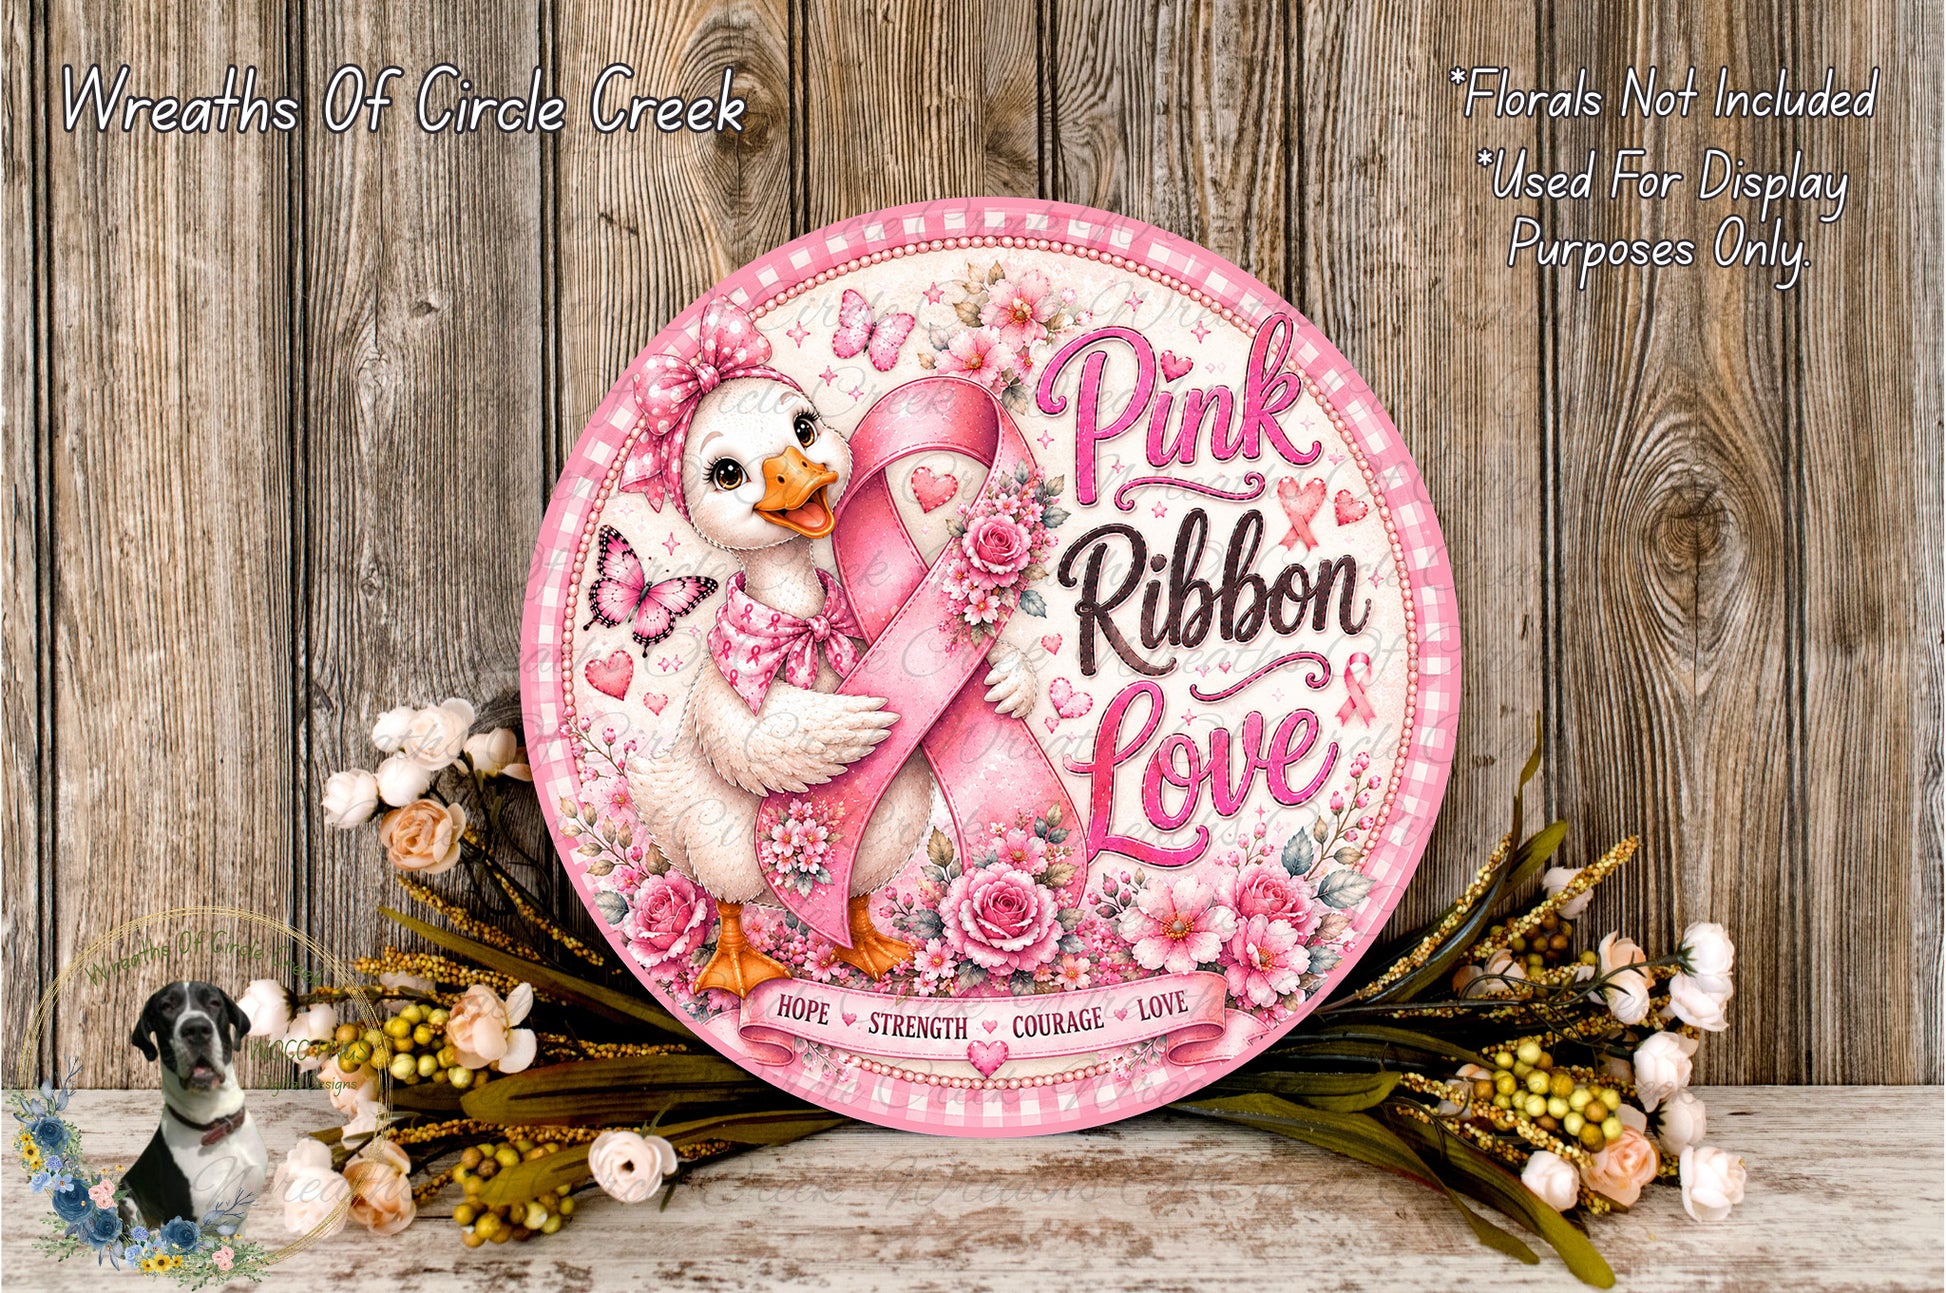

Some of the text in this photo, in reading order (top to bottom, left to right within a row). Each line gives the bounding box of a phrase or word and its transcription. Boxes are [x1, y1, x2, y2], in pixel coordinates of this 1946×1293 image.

[1037, 312, 1325, 506] Pink
[1057, 509, 1371, 676] Ribbon
[1061, 680, 1339, 867] Love
[777, 990, 1189, 1040] HOPE STRENGTH COURAGE LOVE
